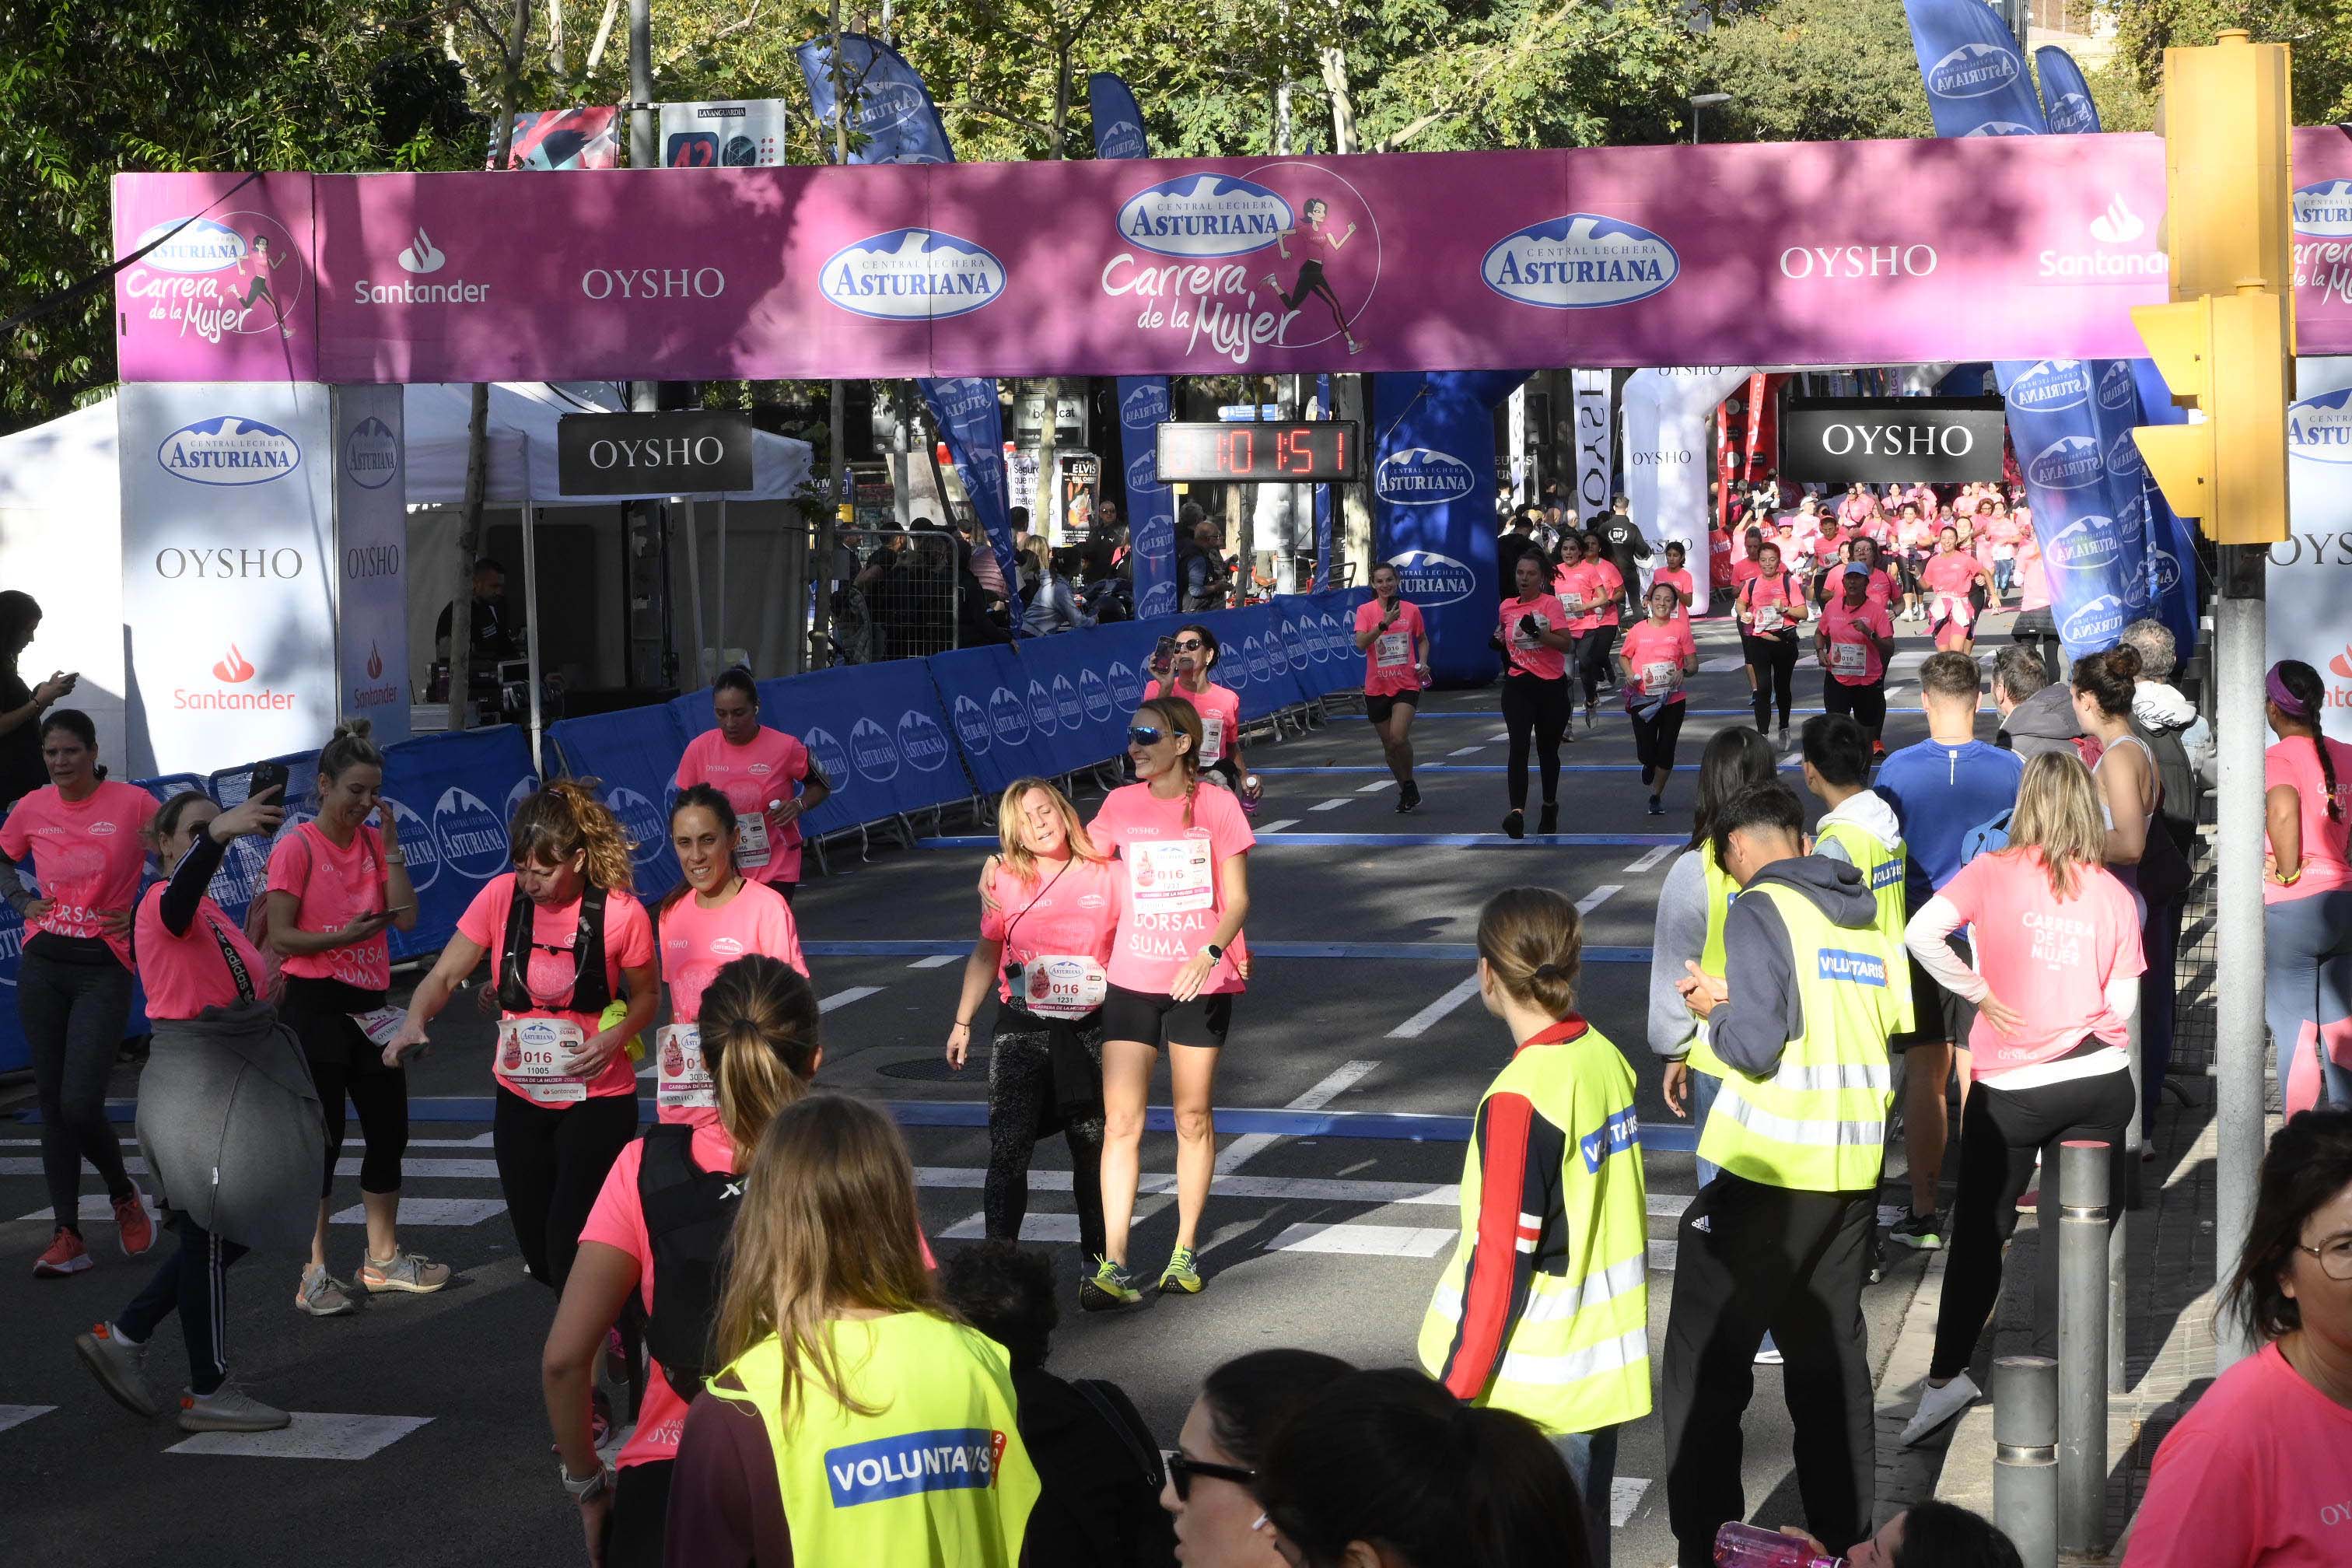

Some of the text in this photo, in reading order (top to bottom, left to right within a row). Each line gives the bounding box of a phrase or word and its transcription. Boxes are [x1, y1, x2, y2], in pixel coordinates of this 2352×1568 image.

[1157, 200, 1274, 211] CENTRAL LECHERA
[1131, 206, 1278, 236] ASTURIANA
[152, 245, 238, 257] STURIANA
[1528, 244, 1657, 257] CENTRAL LECHERA
[1780, 244, 1937, 278] OYSHO
[862, 259, 985, 269] CENTRAL LECHERA
[1101, 254, 1248, 296] Carrera
[1496, 250, 1664, 285] ASTURIANA
[2312, 265, 2325, 287] la
[126, 268, 219, 298] Carrera
[355, 280, 489, 305] Santander
[582, 268, 725, 299] OYSHO
[834, 267, 992, 297] ASTURIANA
[149, 295, 253, 344] de la Mujer
[1137, 291, 1301, 364] de la Mujer
[589, 436, 723, 469] OYSHO
[1822, 424, 1974, 457] OYSHO
[169, 442, 290, 468] ASTURIANA
[1633, 450, 1692, 466] OYSHO
[1015, 476, 1027, 485] que
[1072, 464, 1096, 474] ELVIS
[1380, 471, 1467, 492] ASTURIANA
[156, 548, 303, 579] OYSHO
[347, 544, 399, 579] OYSHO
[1400, 579, 1468, 593] TURIANA
[173, 688, 295, 710] Santander
[354, 684, 397, 710] Santander
[440, 824, 506, 859] ASTURIANA
[1157, 870, 1184, 880] 016
[2022, 912, 2095, 937] CARRERA
[1130, 934, 1187, 955] SUMA
[2035, 929, 2078, 949] DE LA
[2031, 945, 2080, 967] MUJER
[224, 947, 249, 992] adidas
[1053, 984, 1079, 994] 016
[524, 1052, 552, 1063] 016
